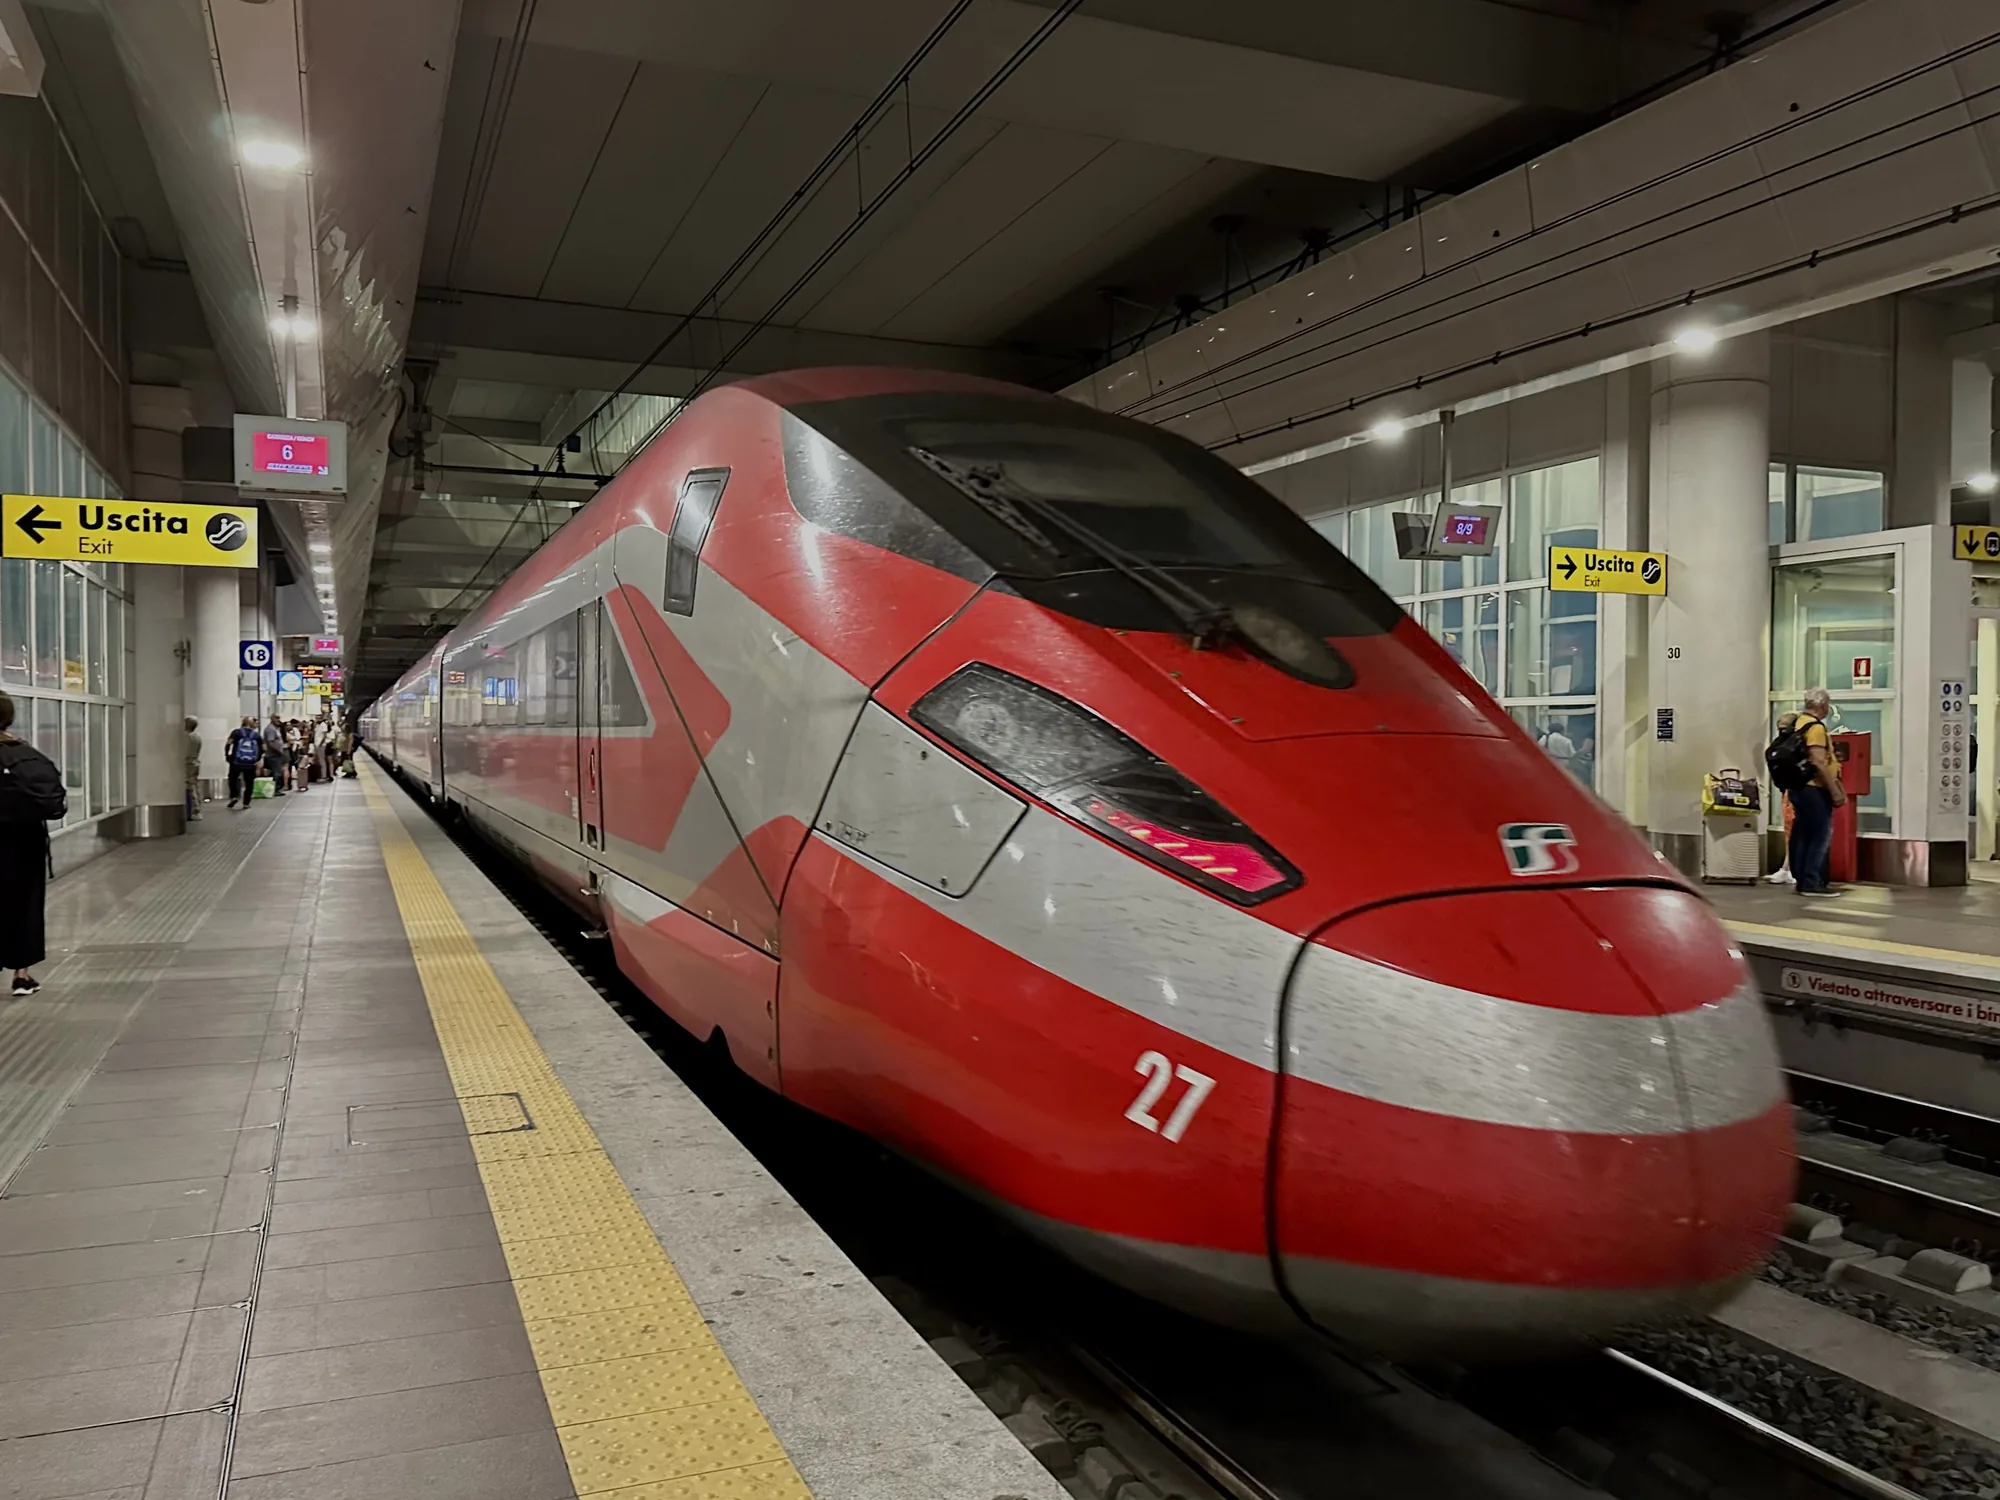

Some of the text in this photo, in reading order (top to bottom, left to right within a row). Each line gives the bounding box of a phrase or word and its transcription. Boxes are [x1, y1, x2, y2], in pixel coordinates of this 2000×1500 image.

[281, 444, 293, 460] 6
[79, 504, 188, 534] Uscita
[1456, 523, 1473, 535] 8/9
[79, 536, 114, 554] Exit
[1584, 553, 1635, 572] Uscita
[1584, 575, 1601, 588] Exit
[247, 649, 266, 661] 18
[1667, 647, 1681, 659] 30
[1808, 975, 1860, 998] Vietato
[1863, 988, 1963, 1016] attraversare
[1967, 1003, 1973, 1018] i
[1124, 1050, 1217, 1144] 27
